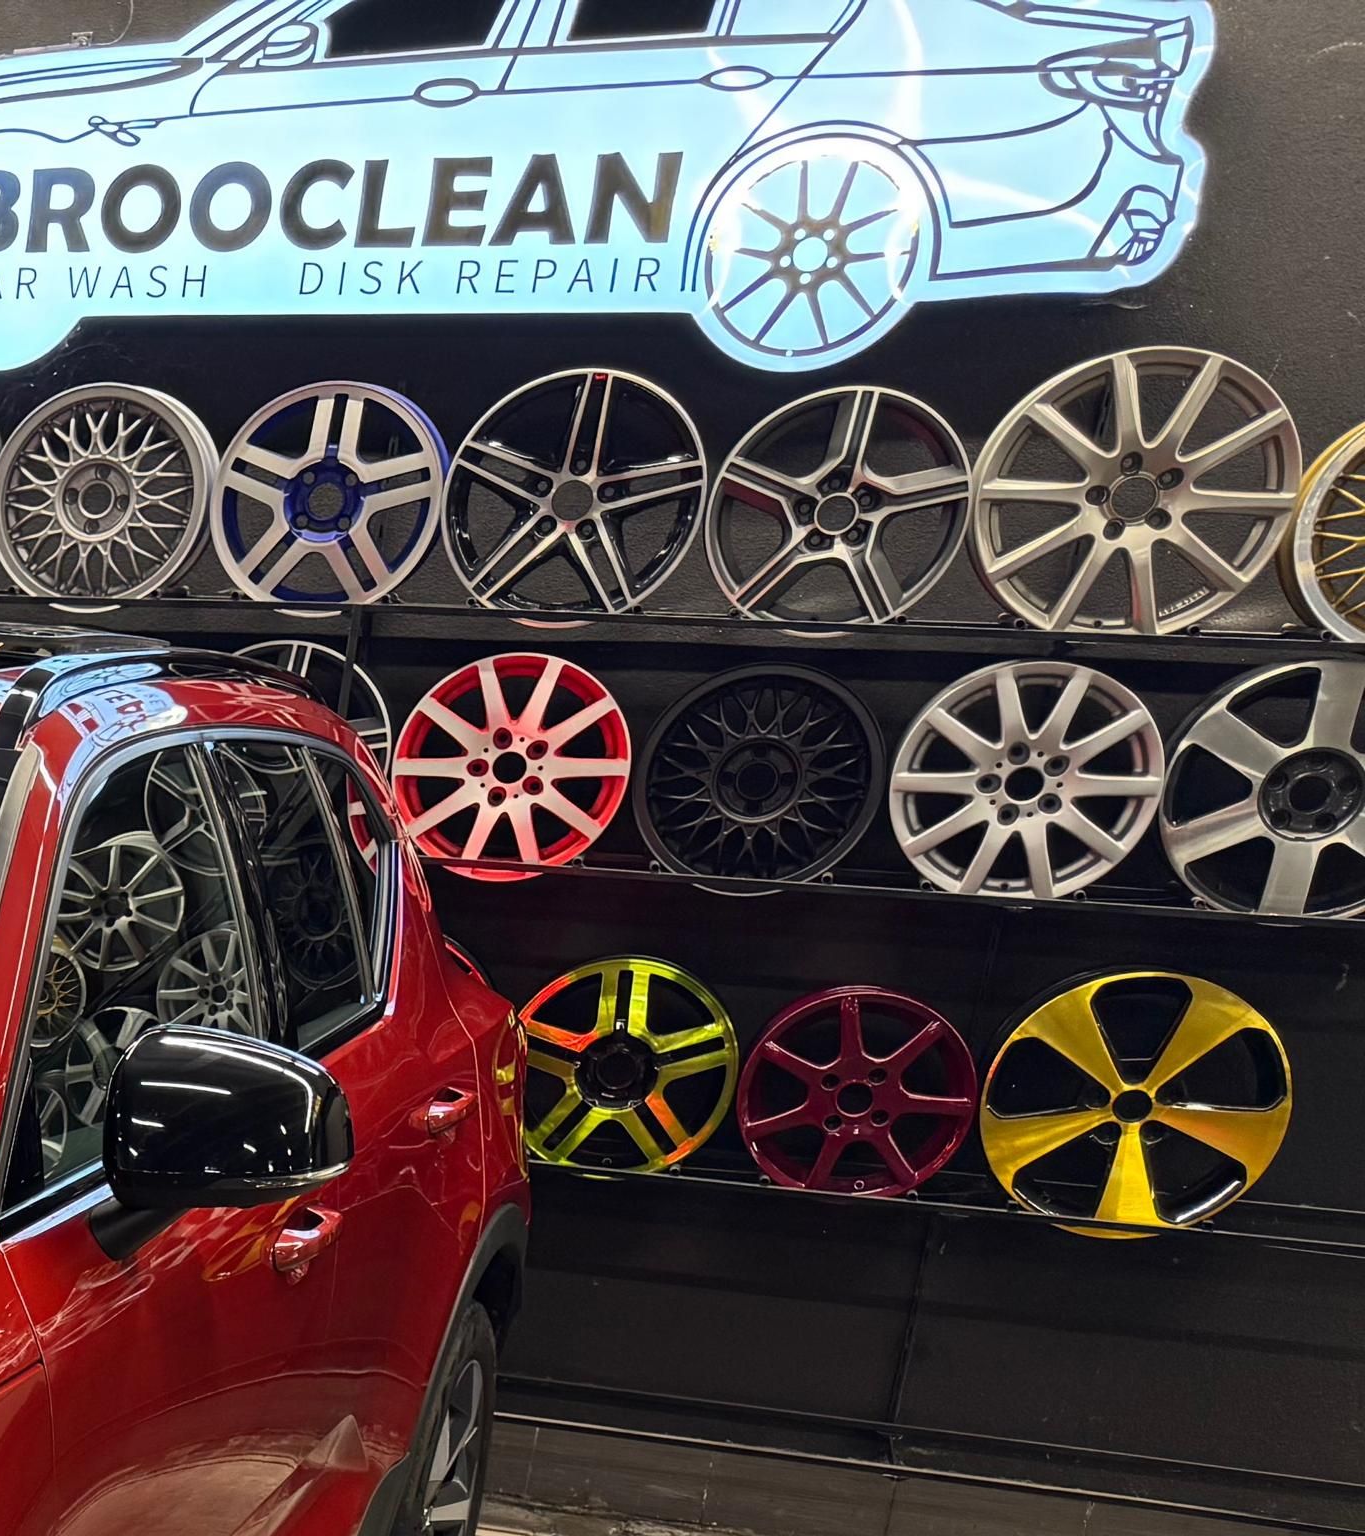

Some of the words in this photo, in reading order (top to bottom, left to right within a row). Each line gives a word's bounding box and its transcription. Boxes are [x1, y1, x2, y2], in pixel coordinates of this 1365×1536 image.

[69, 265, 207, 298] WASH
[299, 260, 424, 295] DISK
[456, 257, 661, 294] REPAIR
